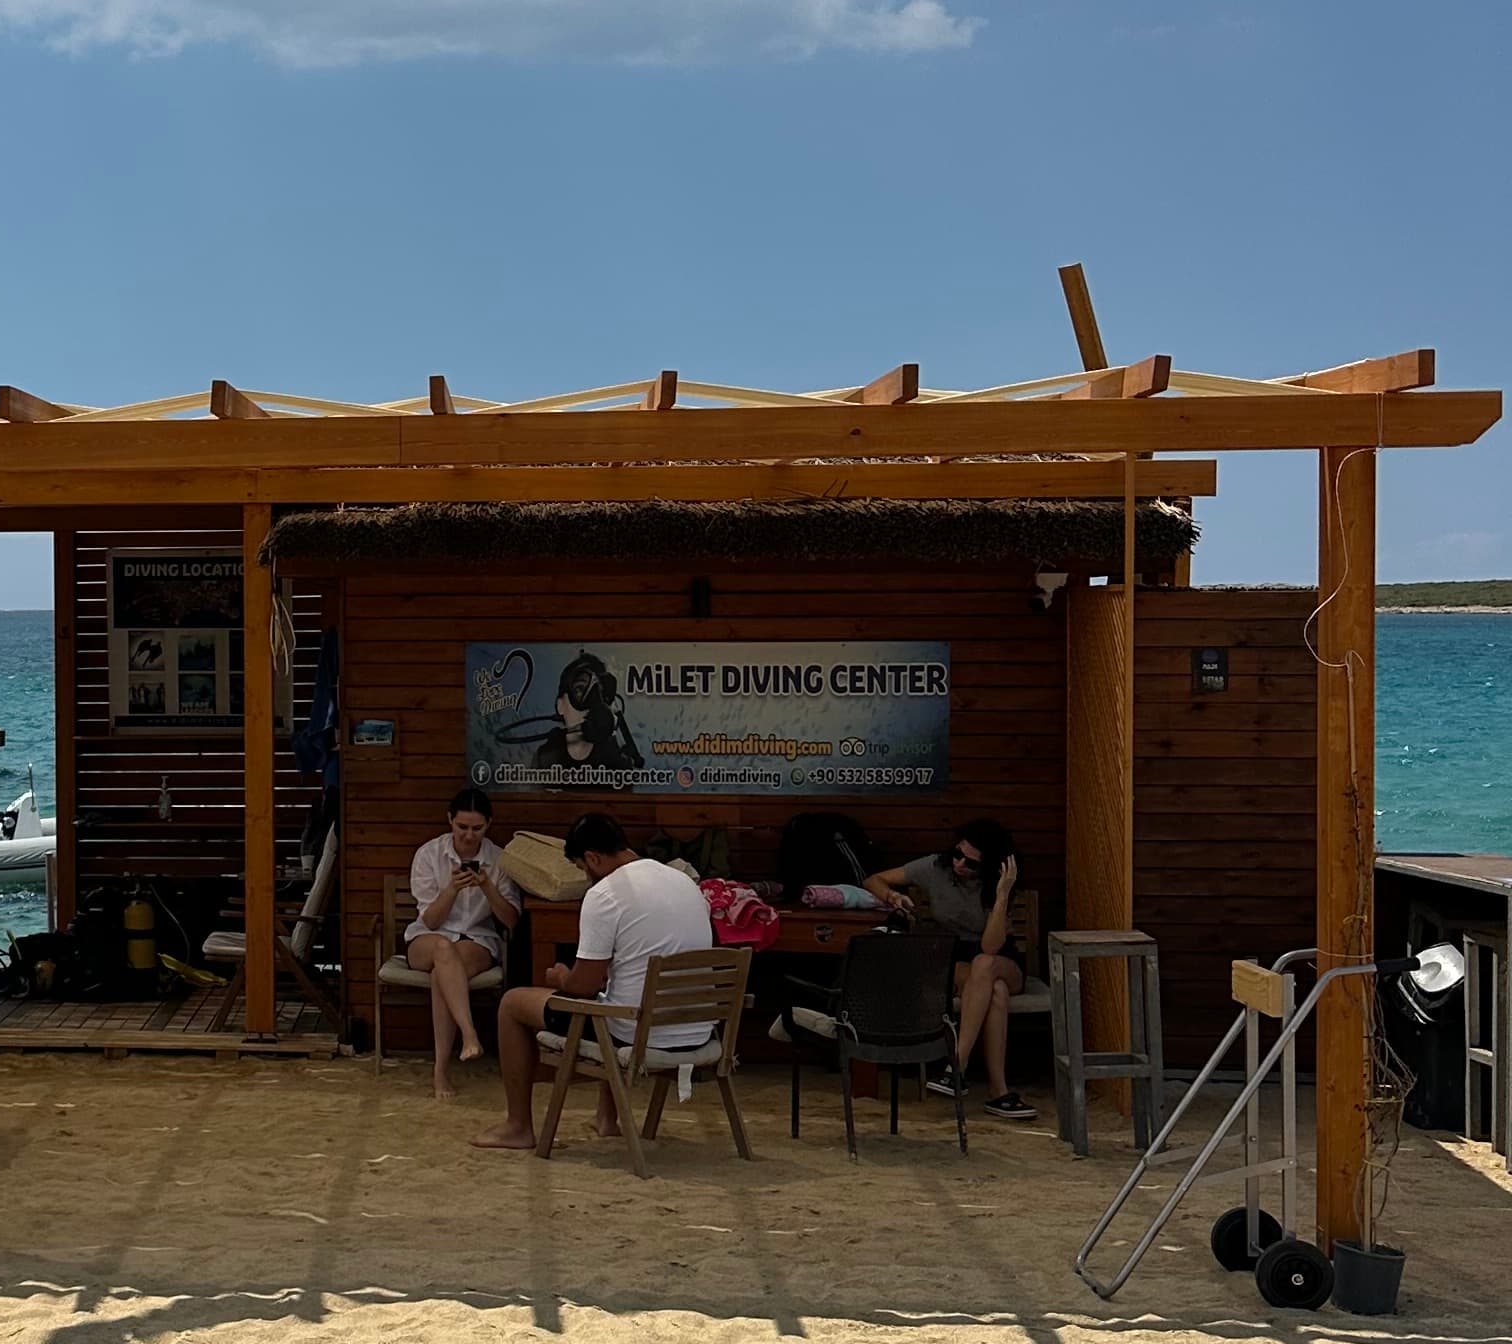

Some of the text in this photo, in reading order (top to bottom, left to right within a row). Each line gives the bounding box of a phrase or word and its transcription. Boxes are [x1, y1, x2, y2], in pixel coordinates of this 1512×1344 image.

[123, 563, 246, 577] DIVING LOCATIO
[721, 664, 824, 695] DIVING
[829, 664, 947, 695] CENTER
[652, 732, 833, 760] www.didimdiving.com
[494, 764, 673, 789] didimmiletdivingcenter
[699, 767, 781, 789] didimdiving
[808, 768, 934, 785] +90 532 585 99 17
